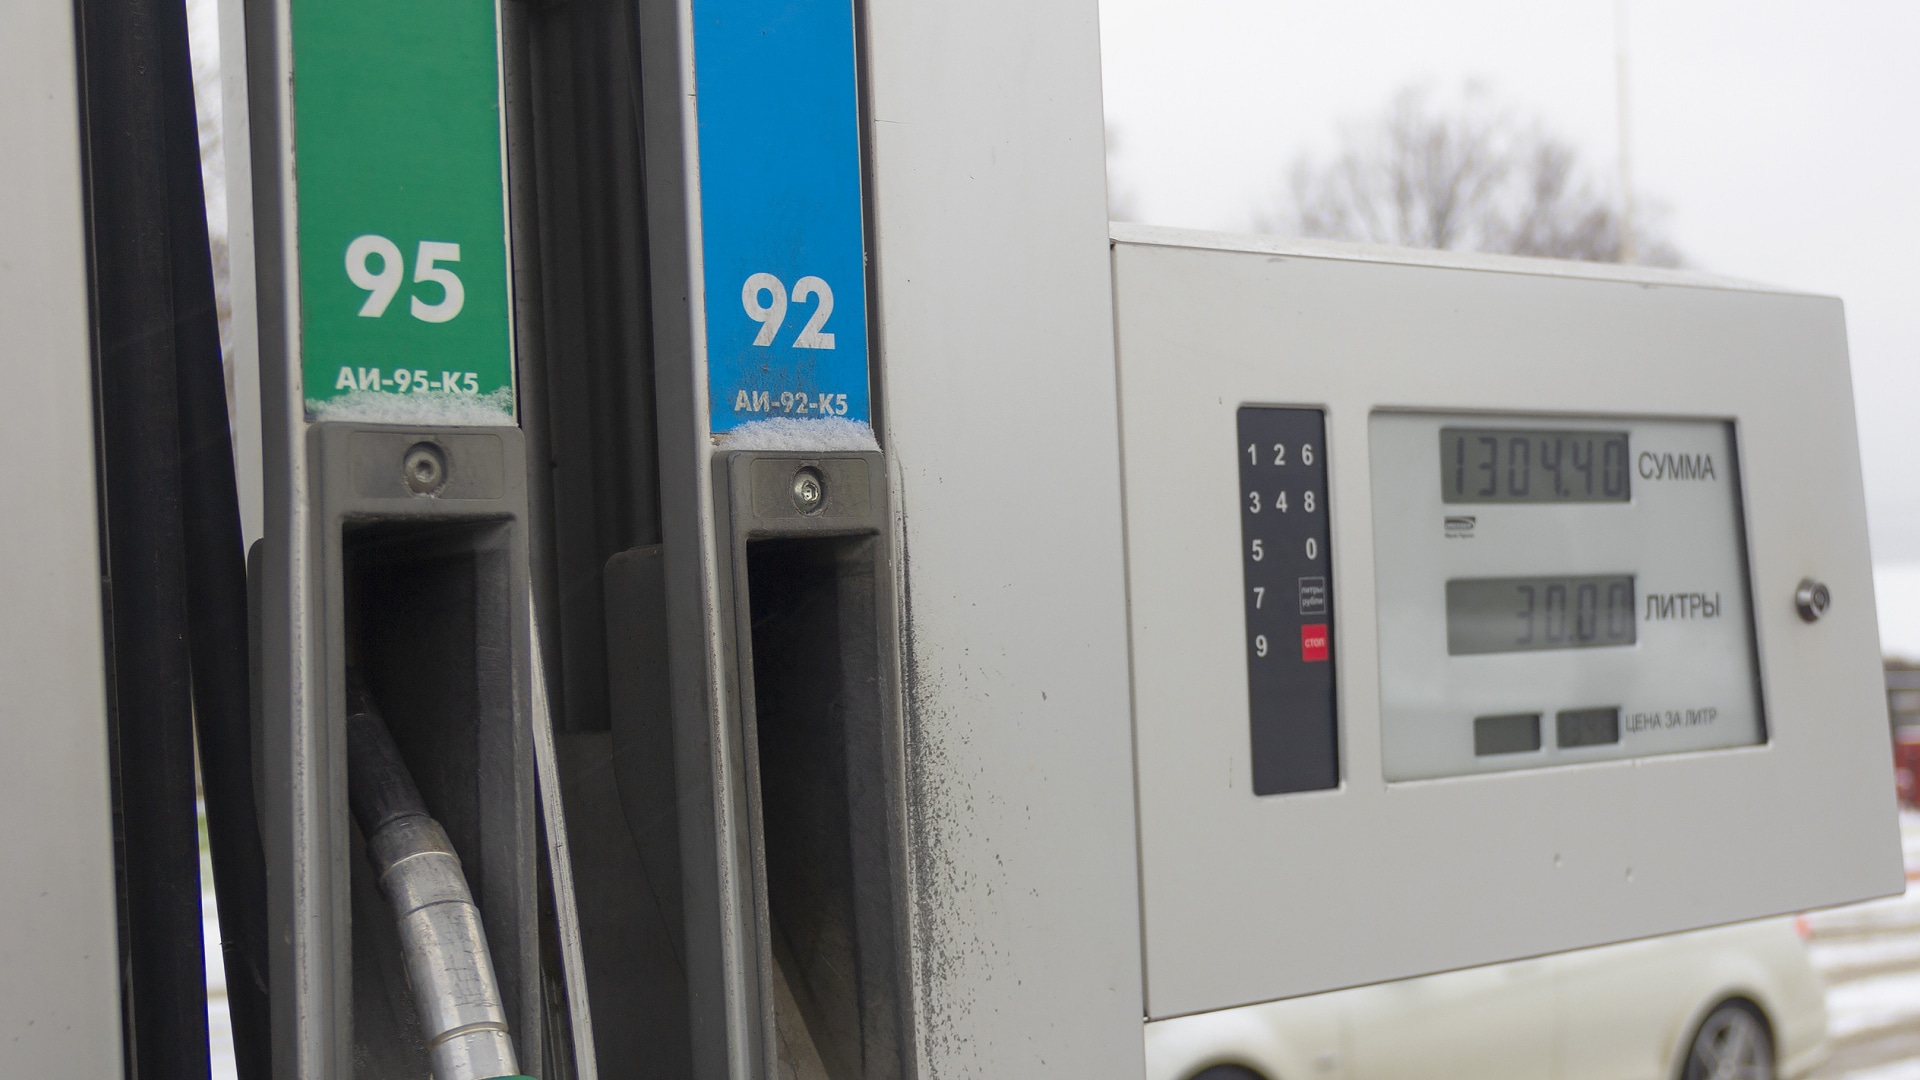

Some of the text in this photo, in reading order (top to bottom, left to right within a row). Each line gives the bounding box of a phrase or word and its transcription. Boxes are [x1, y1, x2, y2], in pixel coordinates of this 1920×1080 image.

[345, 234, 465, 323] 95
[741, 272, 836, 350] 92
[335, 366, 479, 394] АИ-95-К5
[734, 389, 849, 416] АИ-92-К5
[1247, 443, 1314, 466] 1 2 6
[1455, 436, 1626, 498] 1304.40
[1638, 451, 1716, 481] СУММА
[1249, 490, 1315, 514] 3 4 8
[1252, 539, 1264, 562] 5
[1305, 537, 1317, 560] 0
[1253, 587, 1265, 609] 7
[1644, 592, 1721, 621] ЛИТРЫ
[1515, 582, 1627, 645] 30.00
[1255, 634, 1268, 657] 9
[1625, 712, 1661, 733] ЦЕНА
[1664, 709, 1681, 729] ЗА
[1685, 707, 1717, 727] ЛИТР
